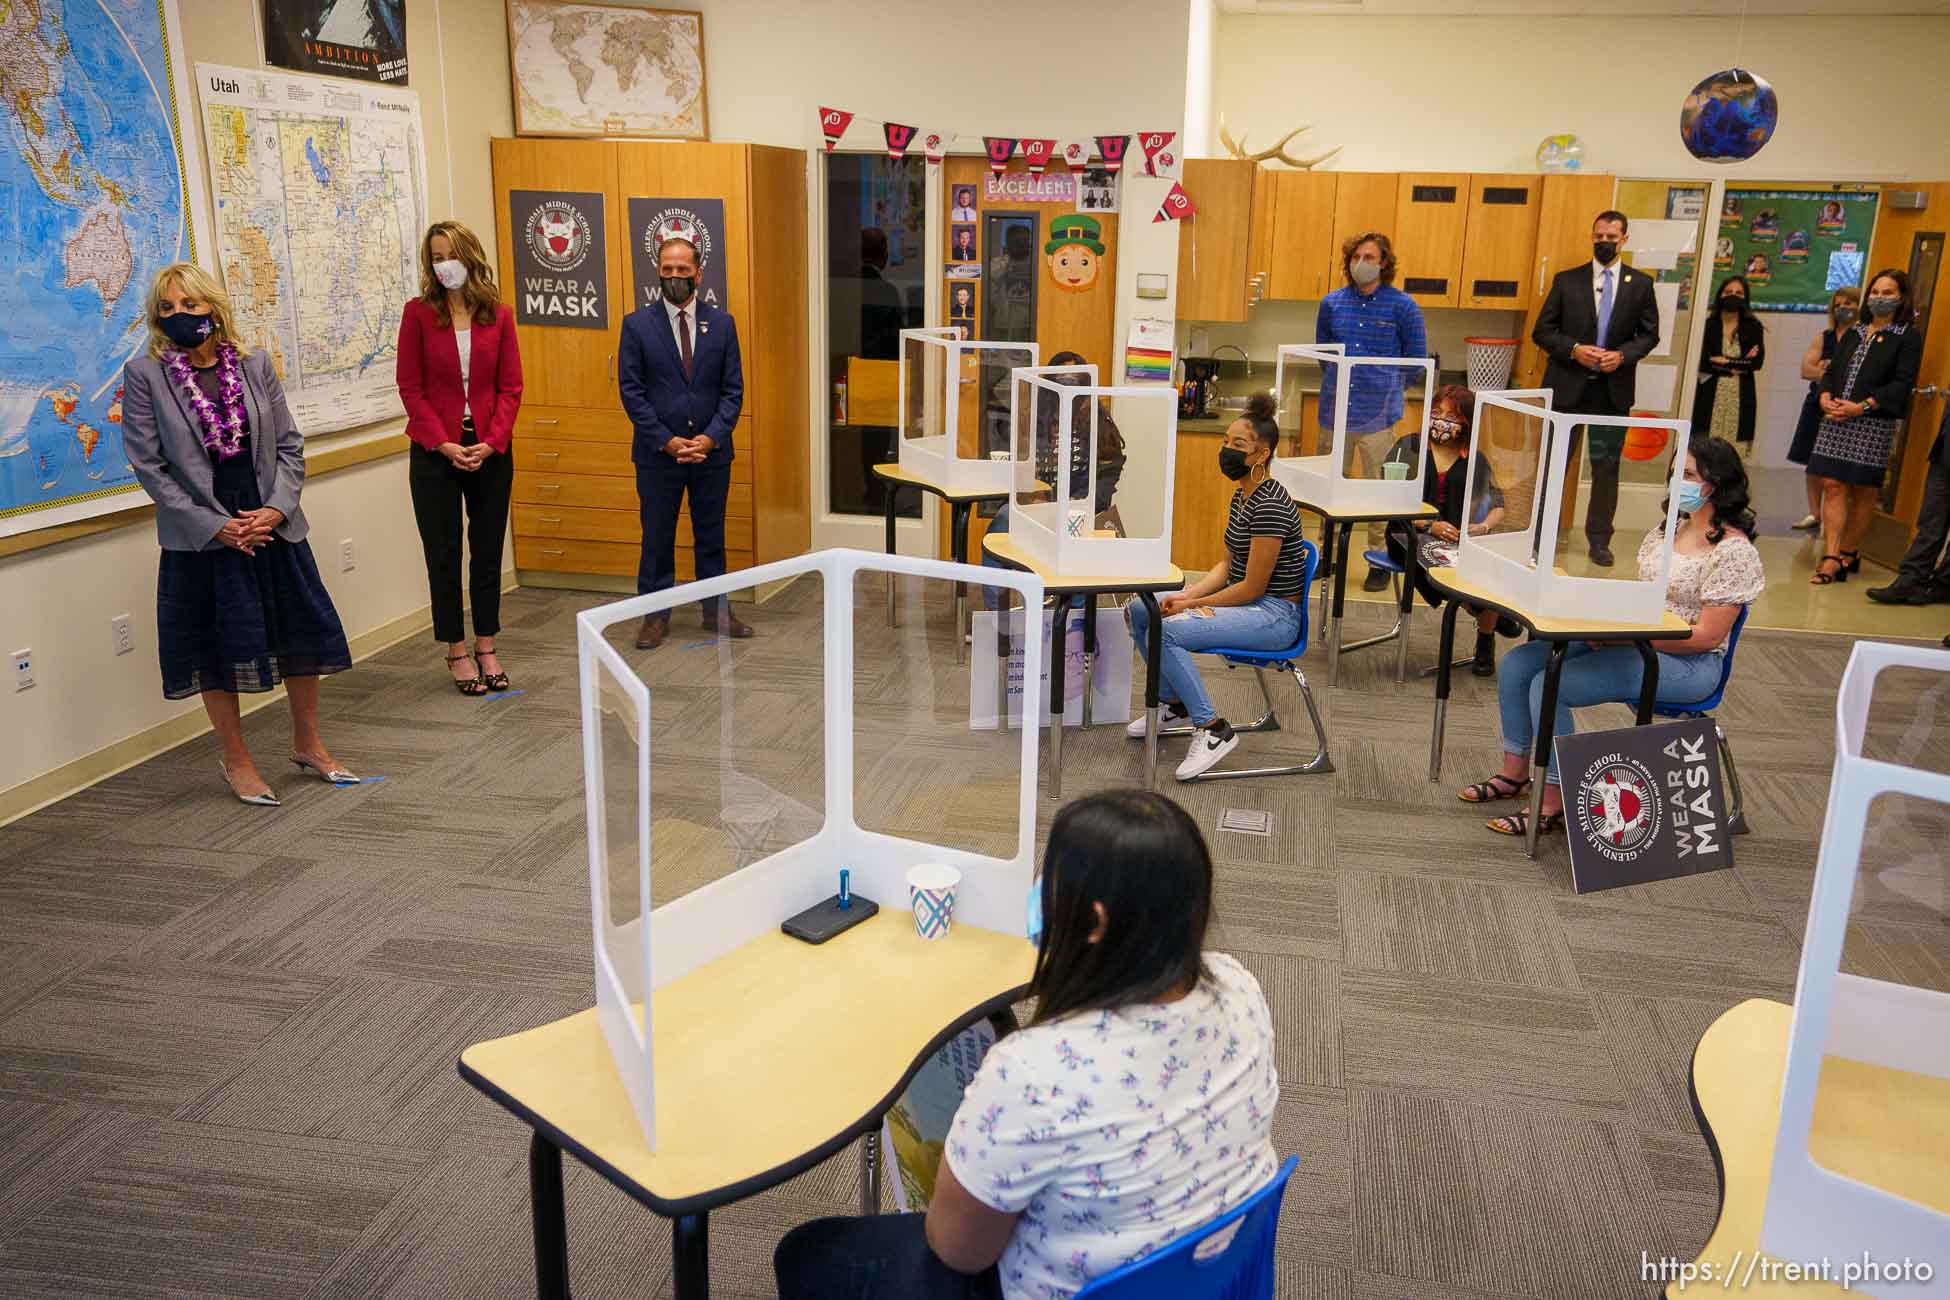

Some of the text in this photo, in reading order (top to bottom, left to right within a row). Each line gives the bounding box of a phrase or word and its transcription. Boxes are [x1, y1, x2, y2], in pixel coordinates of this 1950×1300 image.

[304, 41, 381, 65] AMBITION
[377, 61, 394, 73] MORE
[380, 70, 394, 81] LESS
[210, 76, 240, 94] Utah
[546, 200, 576, 214] MIDDLE
[576, 212, 592, 245] SCHOOL
[664, 208, 696, 220] MIDDLE
[696, 219, 712, 252] SCHOOL
[525, 277, 597, 295] WEAR A
[525, 294, 599, 318] MASK
[1663, 738, 1694, 860] WEAR A
[1680, 734, 1720, 855] MASK
[1577, 752, 1638, 862] GLENDALE MIDDLE SCHOOL
